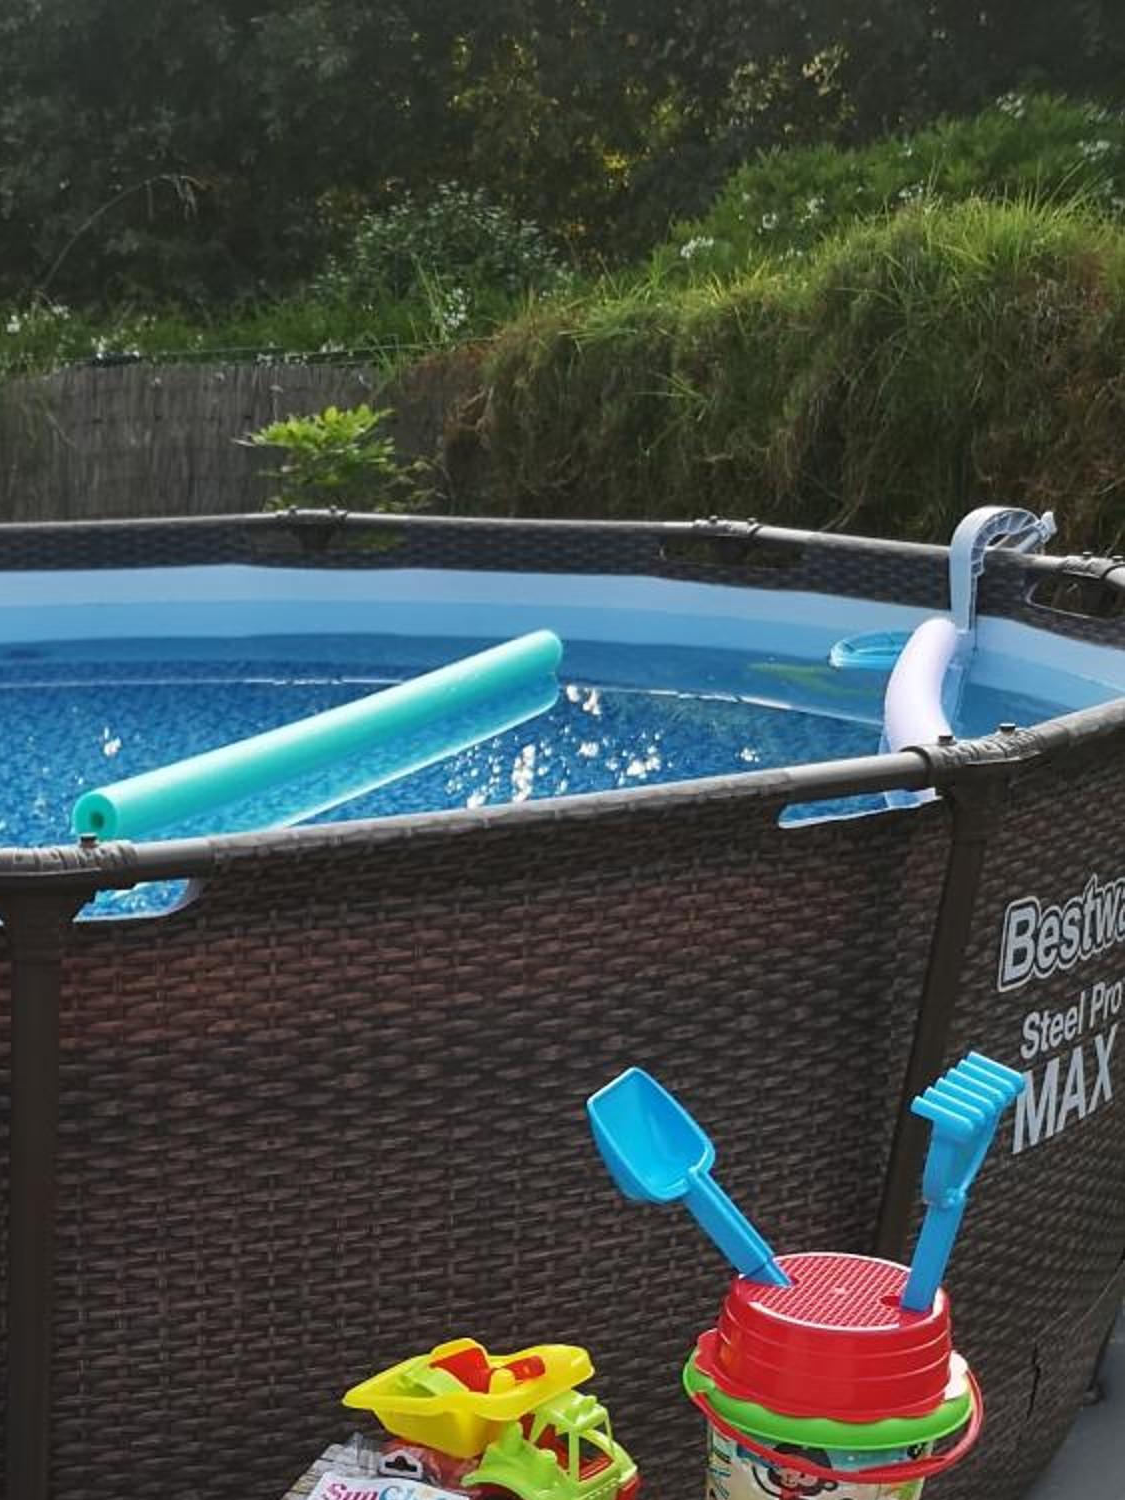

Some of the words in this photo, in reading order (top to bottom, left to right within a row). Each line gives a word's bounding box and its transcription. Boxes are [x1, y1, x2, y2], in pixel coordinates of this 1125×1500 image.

[1020, 991, 1084, 1060] Steel
[1089, 981, 1123, 1029] Pro
[1012, 1023, 1119, 1156] MAX
